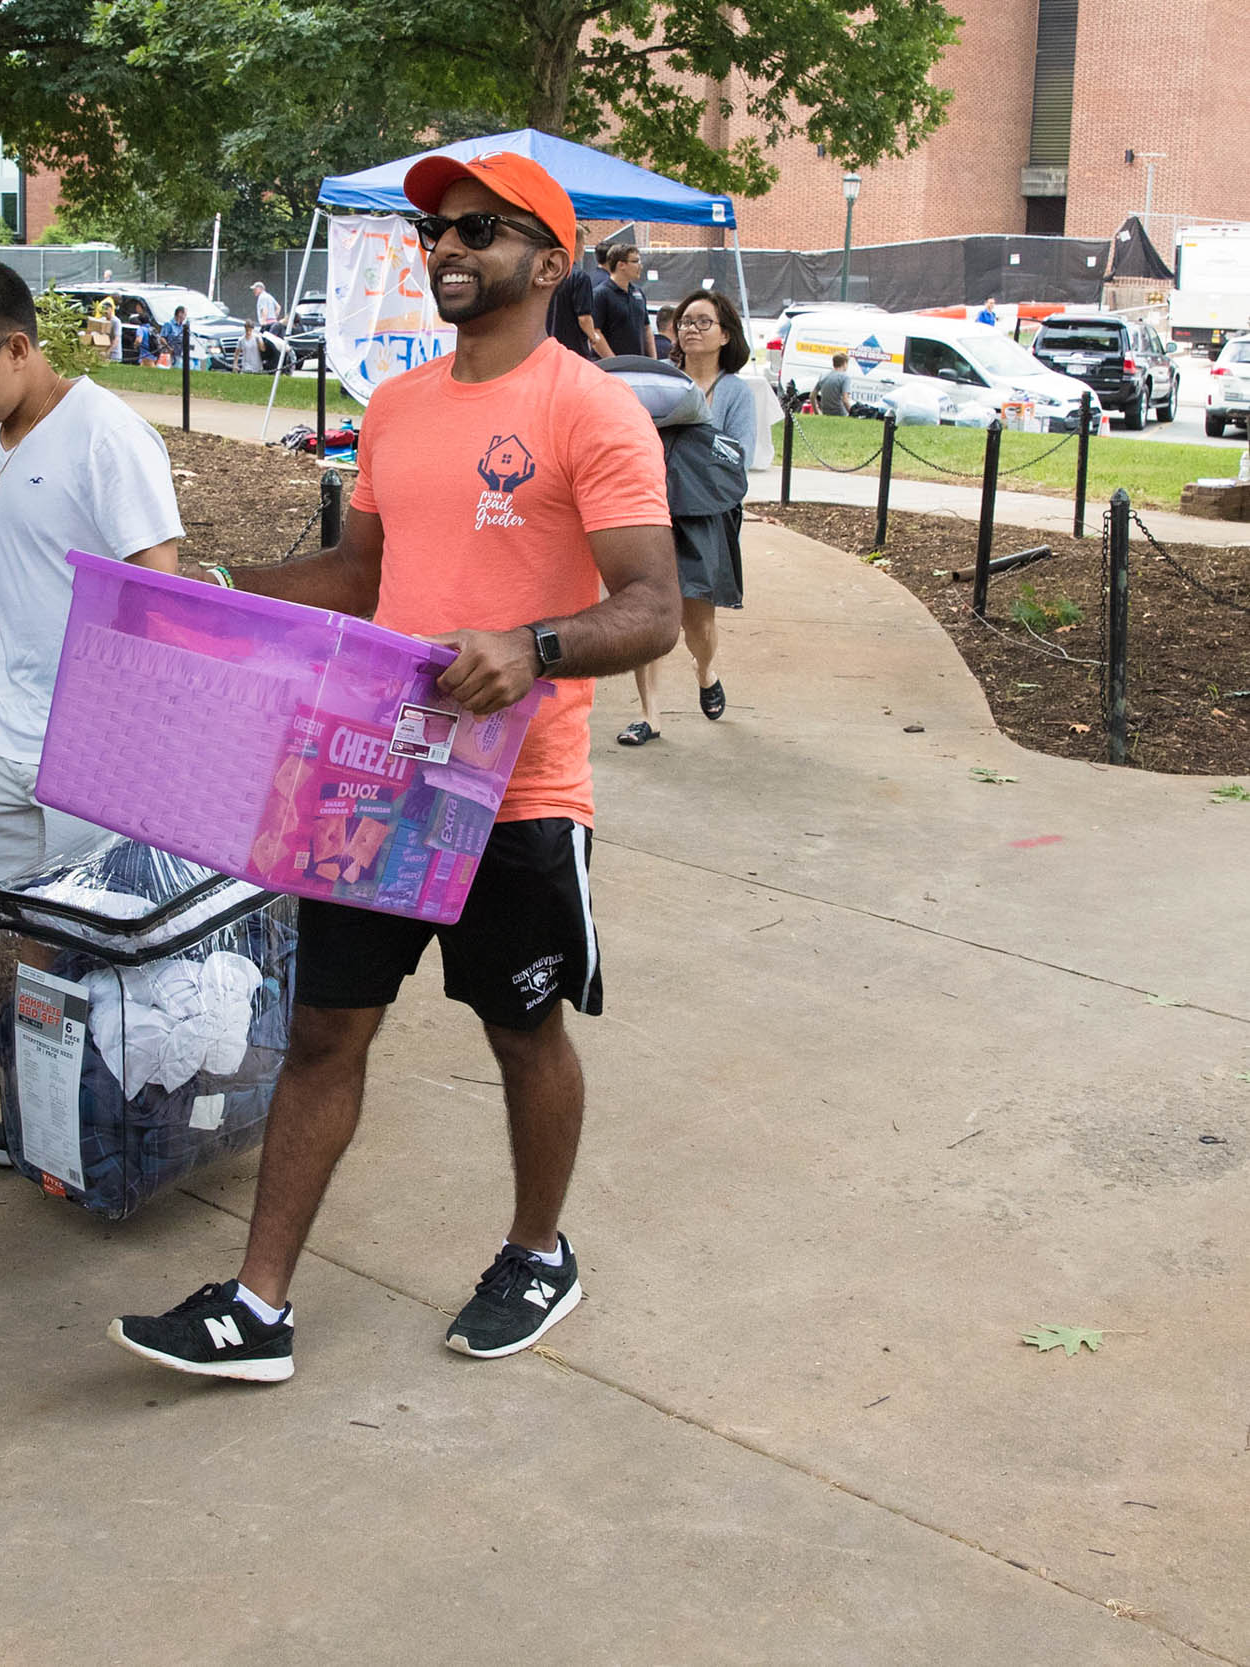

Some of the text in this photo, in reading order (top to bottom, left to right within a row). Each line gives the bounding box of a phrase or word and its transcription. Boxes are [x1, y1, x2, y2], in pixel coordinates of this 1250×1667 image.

[477, 491, 513, 511] Lead
[487, 492, 503, 500] UVA
[475, 507, 526, 531] Greeter
[337, 781, 380, 801] DUOZ
[441, 796, 458, 844] Extra
[18, 1004, 39, 1019] BED
[40, 1012, 61, 1026] SET
[19, 994, 62, 1016] COMPLETE
[64, 1034, 80, 1043] PIECE
[65, 1022, 73, 1033] 6
[523, 1278, 557, 1310] N
[204, 1314, 244, 1350] N
